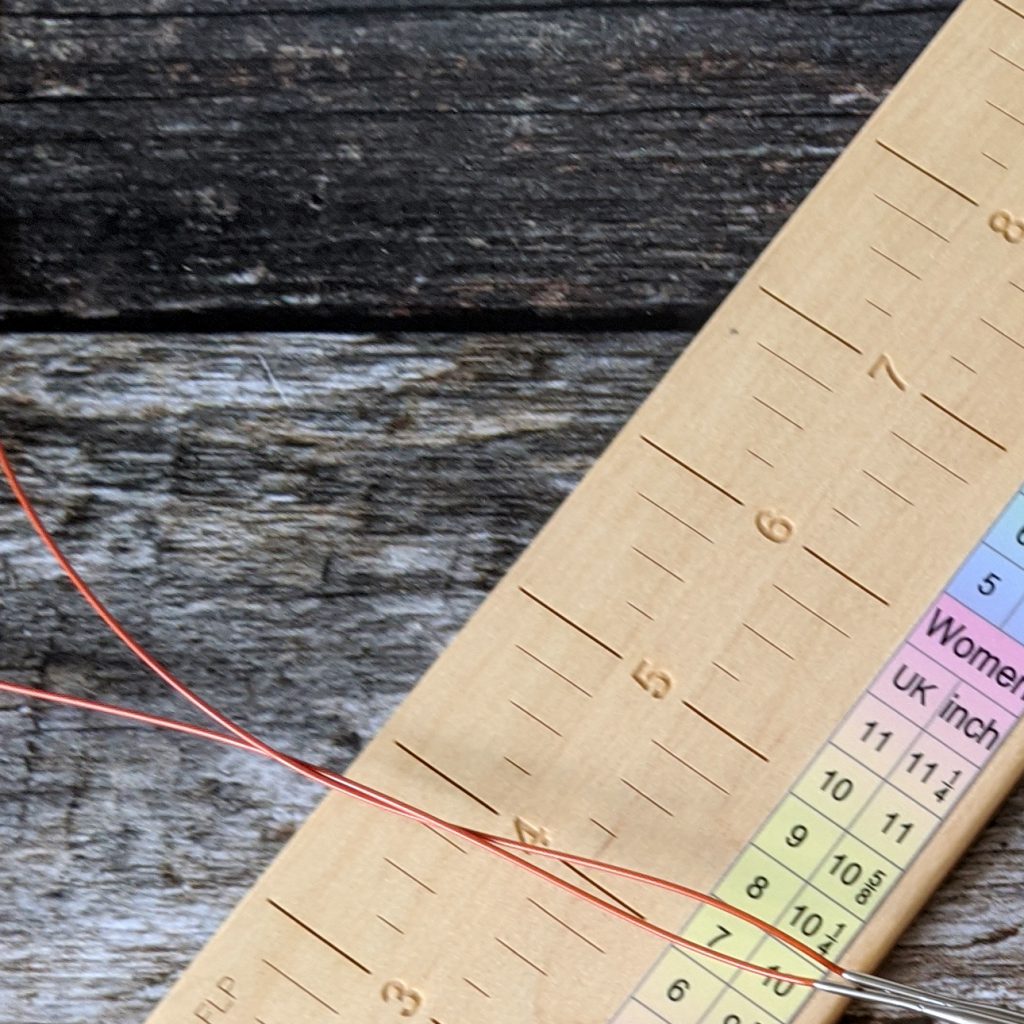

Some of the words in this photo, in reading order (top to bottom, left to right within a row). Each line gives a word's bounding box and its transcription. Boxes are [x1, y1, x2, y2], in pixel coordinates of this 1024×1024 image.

[867, 353, 909, 392] 7
[754, 508, 796, 544] 6
[977, 573, 1001, 596] 5
[631, 658, 673, 699] 5
[892, 664, 938, 707] UK
[938, 693, 1000, 751] inch
[859, 721, 893, 752] 11
[819, 770, 854, 802] 10
[880, 813, 914, 844] 11
[785, 825, 808, 847] 9
[745, 875, 770, 900] 8
[707, 924, 732, 947] 7
[380, 979, 424, 1017] 3
[666, 978, 691, 1002] 6
